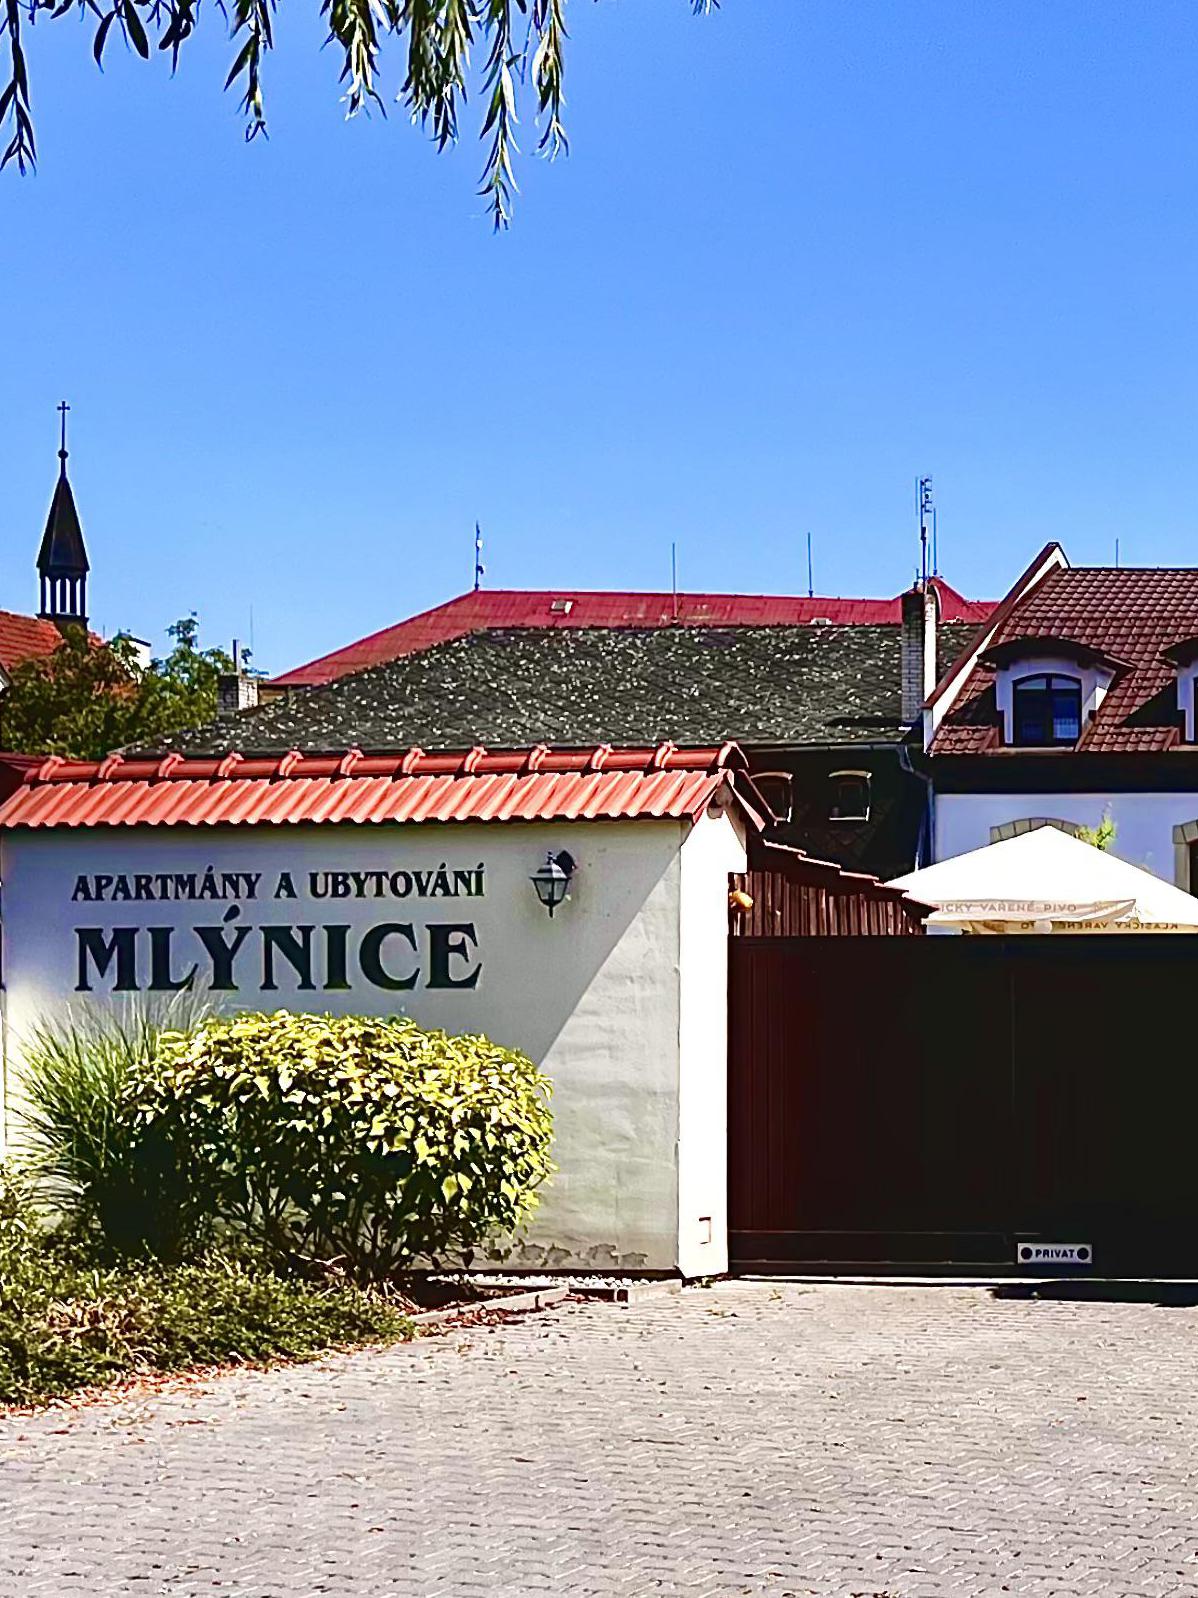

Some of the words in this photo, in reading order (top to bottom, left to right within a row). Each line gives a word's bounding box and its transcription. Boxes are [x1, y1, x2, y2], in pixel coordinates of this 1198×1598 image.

[72, 866, 261, 901] APARTMÁNY
[275, 872, 297, 898] A
[309, 863, 485, 897] UBYTOVÁNÍ
[1044, 903, 1077, 912] PIVO
[74, 904, 483, 991] MLÝNICE
[1035, 1248, 1075, 1258] PRIVAT
